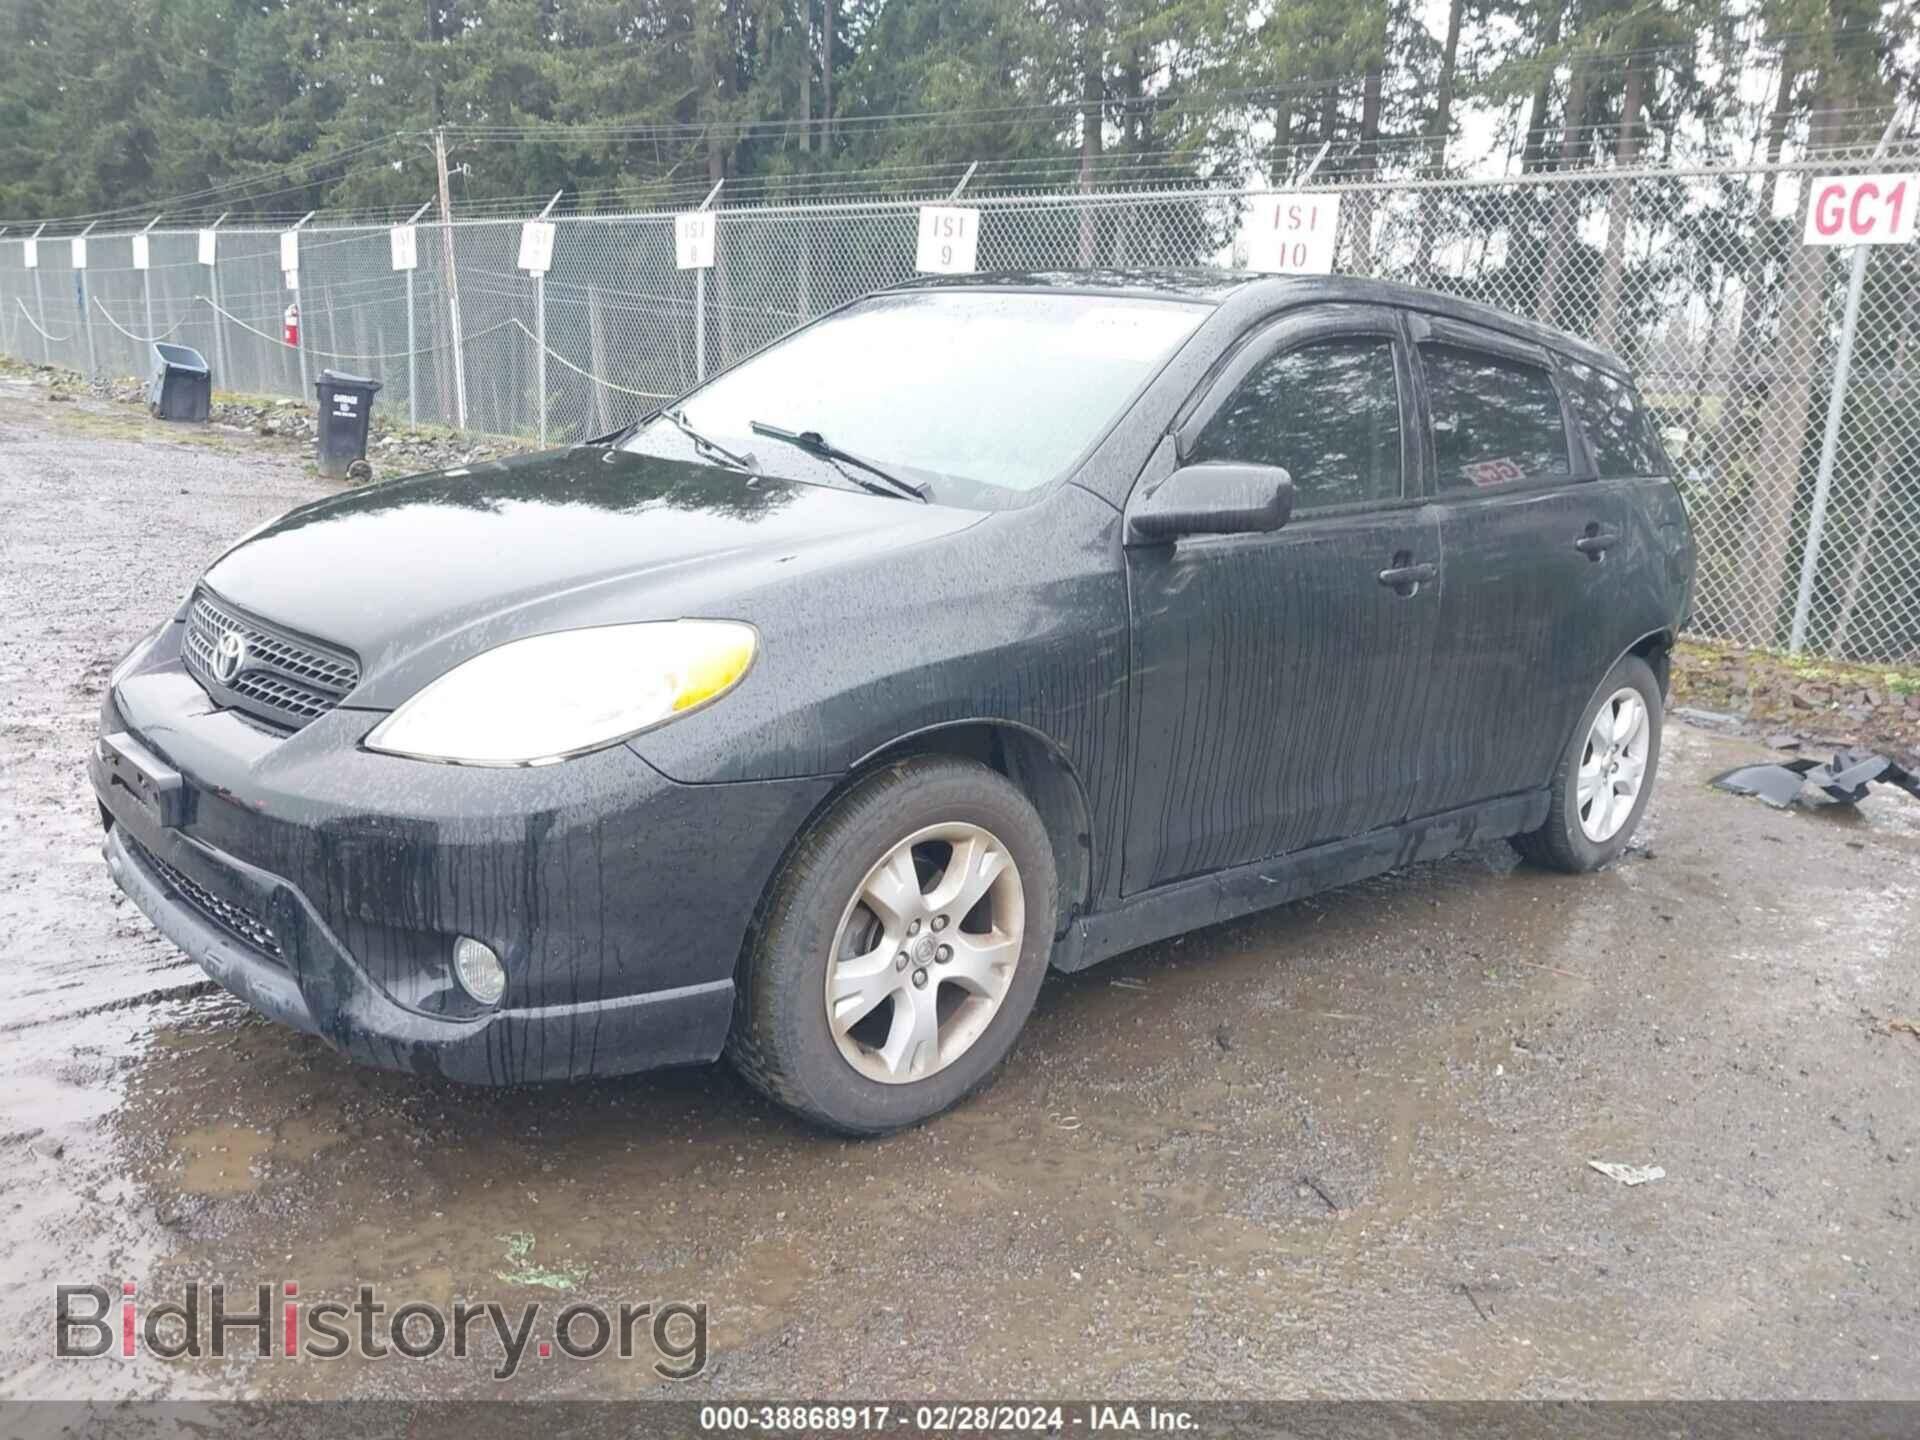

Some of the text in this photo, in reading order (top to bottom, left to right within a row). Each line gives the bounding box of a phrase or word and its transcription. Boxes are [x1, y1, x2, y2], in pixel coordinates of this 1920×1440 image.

[1815, 181, 1907, 237] GC1
[941, 245, 952, 265] 9
[1279, 240, 1307, 268] 10
